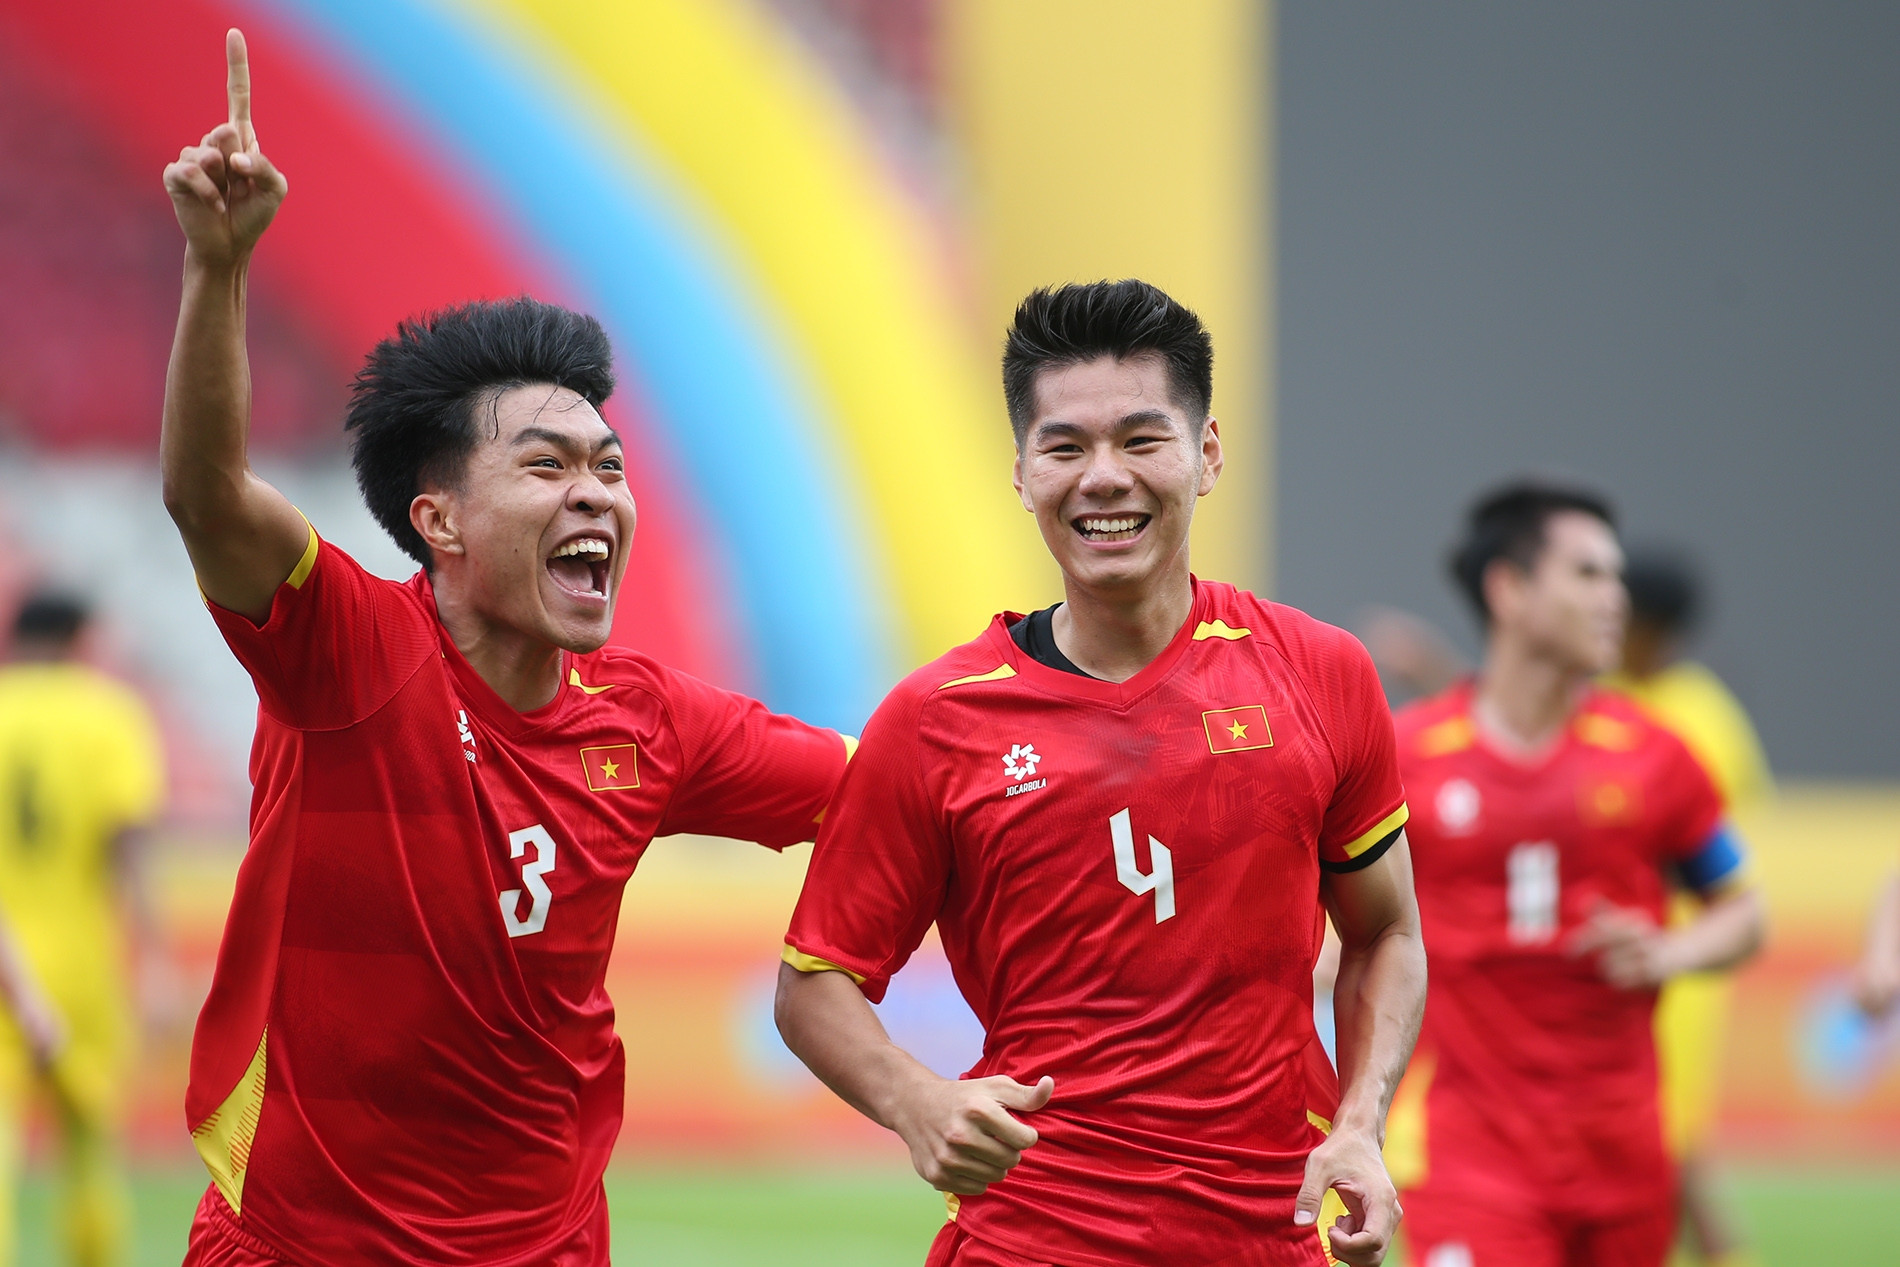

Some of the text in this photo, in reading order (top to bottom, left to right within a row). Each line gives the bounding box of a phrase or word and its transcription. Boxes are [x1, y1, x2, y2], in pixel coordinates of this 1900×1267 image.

[1005, 777, 1047, 798] JOGARBOLA
[499, 823, 557, 938] 3
[1109, 807, 1176, 925] 4
